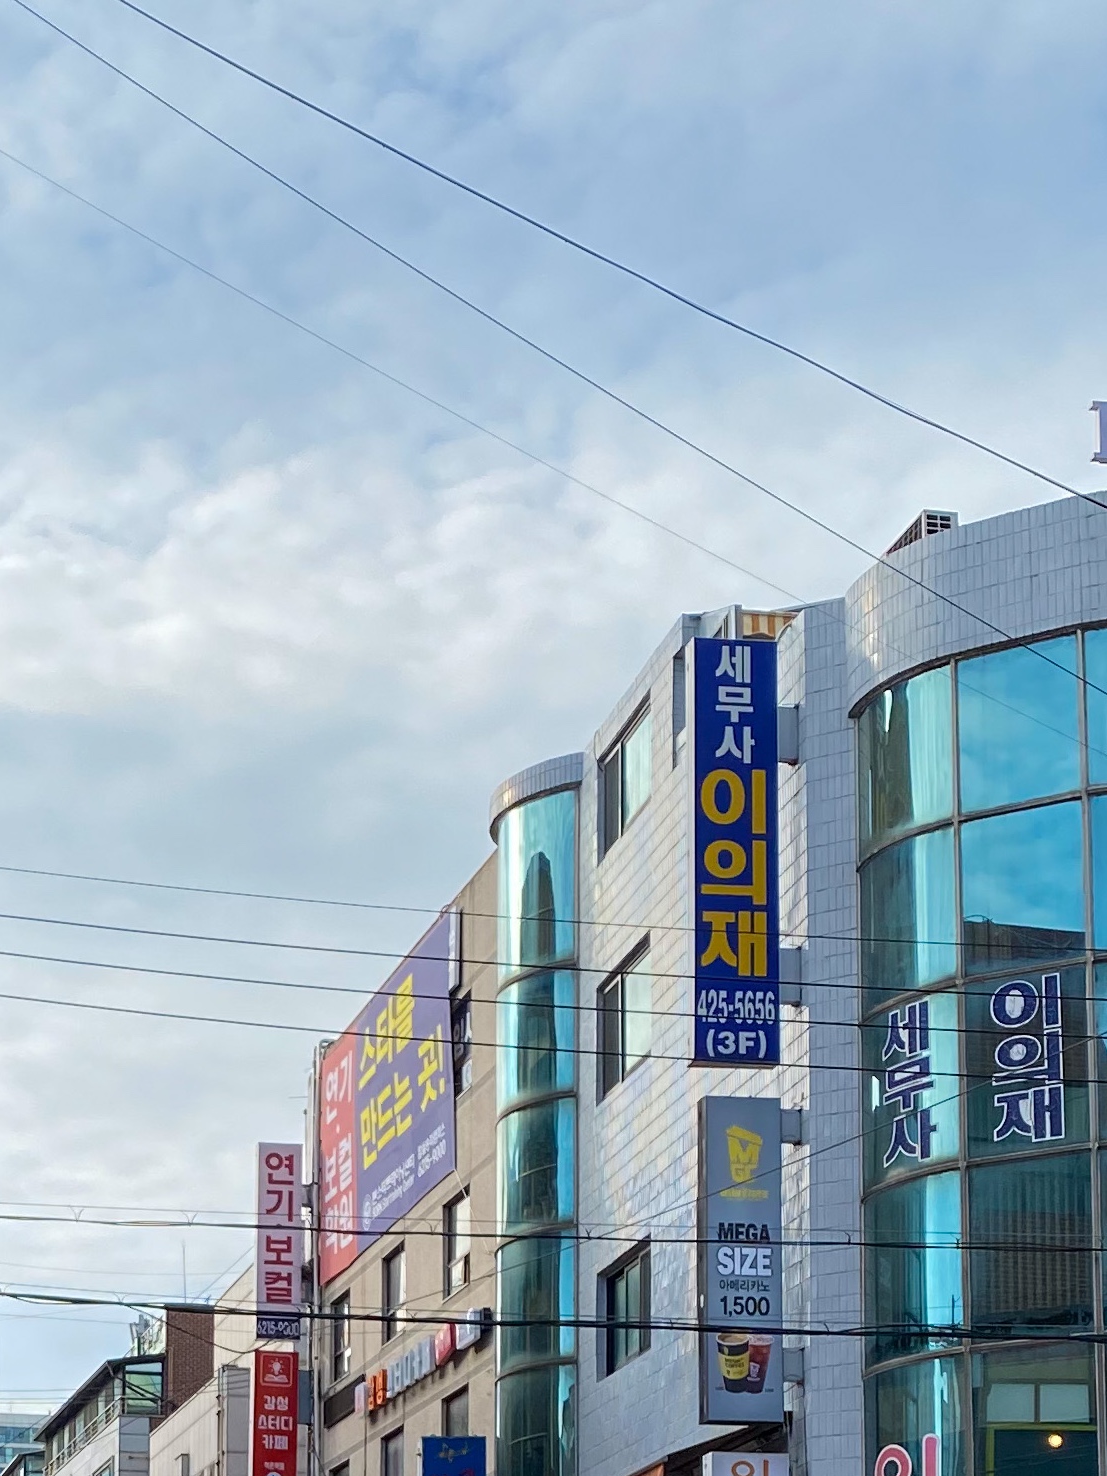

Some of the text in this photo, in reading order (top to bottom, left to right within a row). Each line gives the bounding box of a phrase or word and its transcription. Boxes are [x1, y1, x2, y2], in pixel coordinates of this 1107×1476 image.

[700, 644, 768, 977] 세무사 이의재
[698, 989, 775, 1025] 425-5656
[706, 1031, 767, 1058] (3F)
[990, 972, 1066, 1143] 이의재
[325, 1050, 353, 1124] 연기
[882, 1000, 936, 1168] 세무사
[264, 1152, 294, 1304] 연기 보컬
[718, 1222, 771, 1243] MEGA
[717, 1246, 772, 1276] SIZE
[720, 1279, 771, 1292] 아메리카노
[720, 1296, 771, 1317] 1,500
[264, 1395, 288, 1411] 감성
[258, 1414, 293, 1431] 스터디
[262, 1434, 289, 1450] 카페
